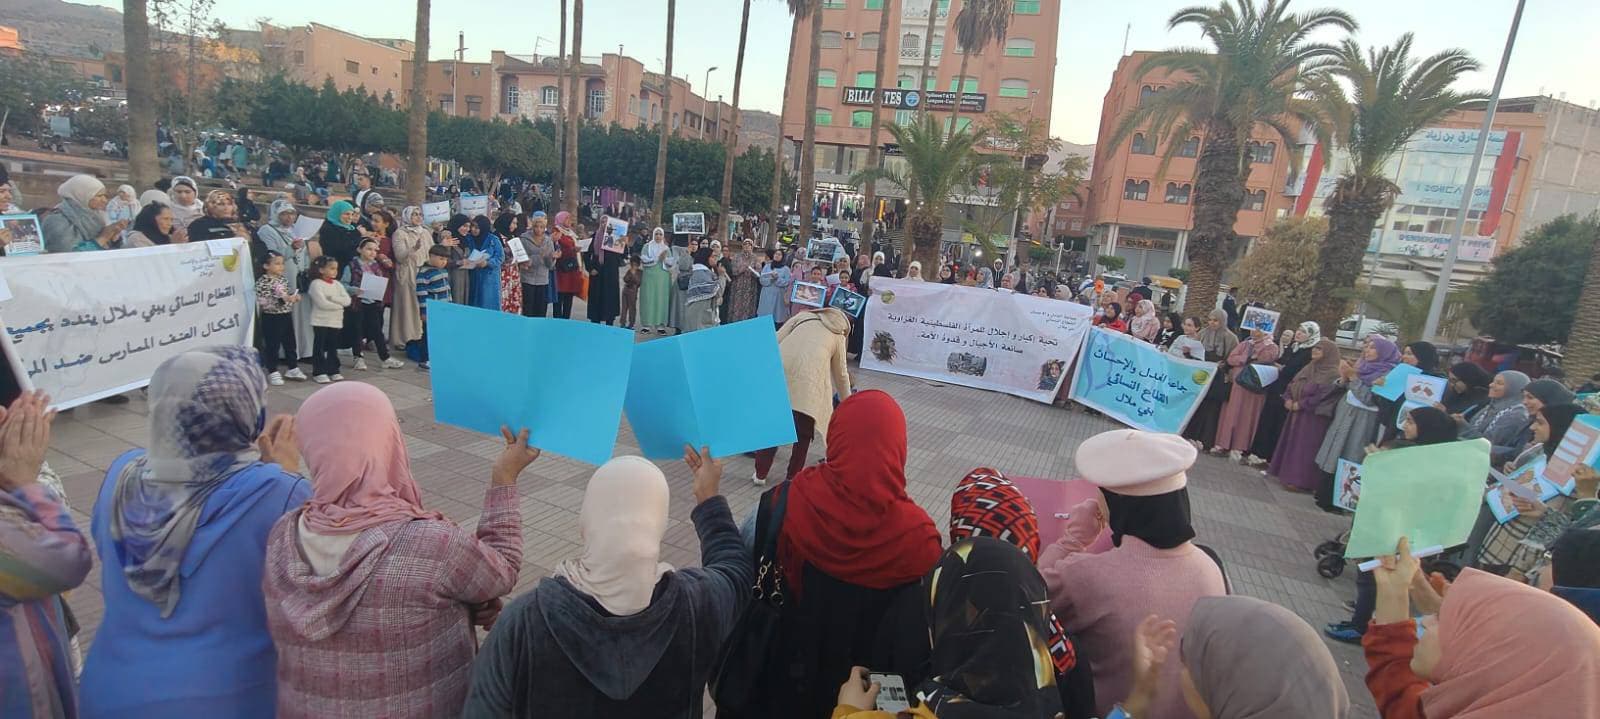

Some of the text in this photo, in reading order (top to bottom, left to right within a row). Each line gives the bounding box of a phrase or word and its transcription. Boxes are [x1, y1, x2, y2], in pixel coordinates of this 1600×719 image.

[169, 291, 204, 316] النسائي
[207, 286, 235, 307] القطاع
[61, 314, 98, 327] يندد
[103, 304, 137, 323] ملال
[142, 304, 165, 322] ببني
[887, 312, 917, 324] الغزاوية
[202, 313, 240, 337] أشكال
[920, 317, 961, 329] الفلسطينية
[963, 322, 985, 333] للمرأة
[159, 326, 197, 346] العنف
[941, 333, 960, 344] قدوة
[987, 327, 1010, 339] إجلال
[1001, 343, 1023, 354] صانعة
[1039, 336, 1058, 347] تحية
[99, 336, 154, 364] الممارس
[54, 354, 93, 369] ضد
[1093, 349, 1136, 374] والإحسان
[1139, 368, 1167, 383] العدل
[1106, 373, 1169, 405] القطاع النسائي
[1115, 393, 1154, 417] بني ملال
